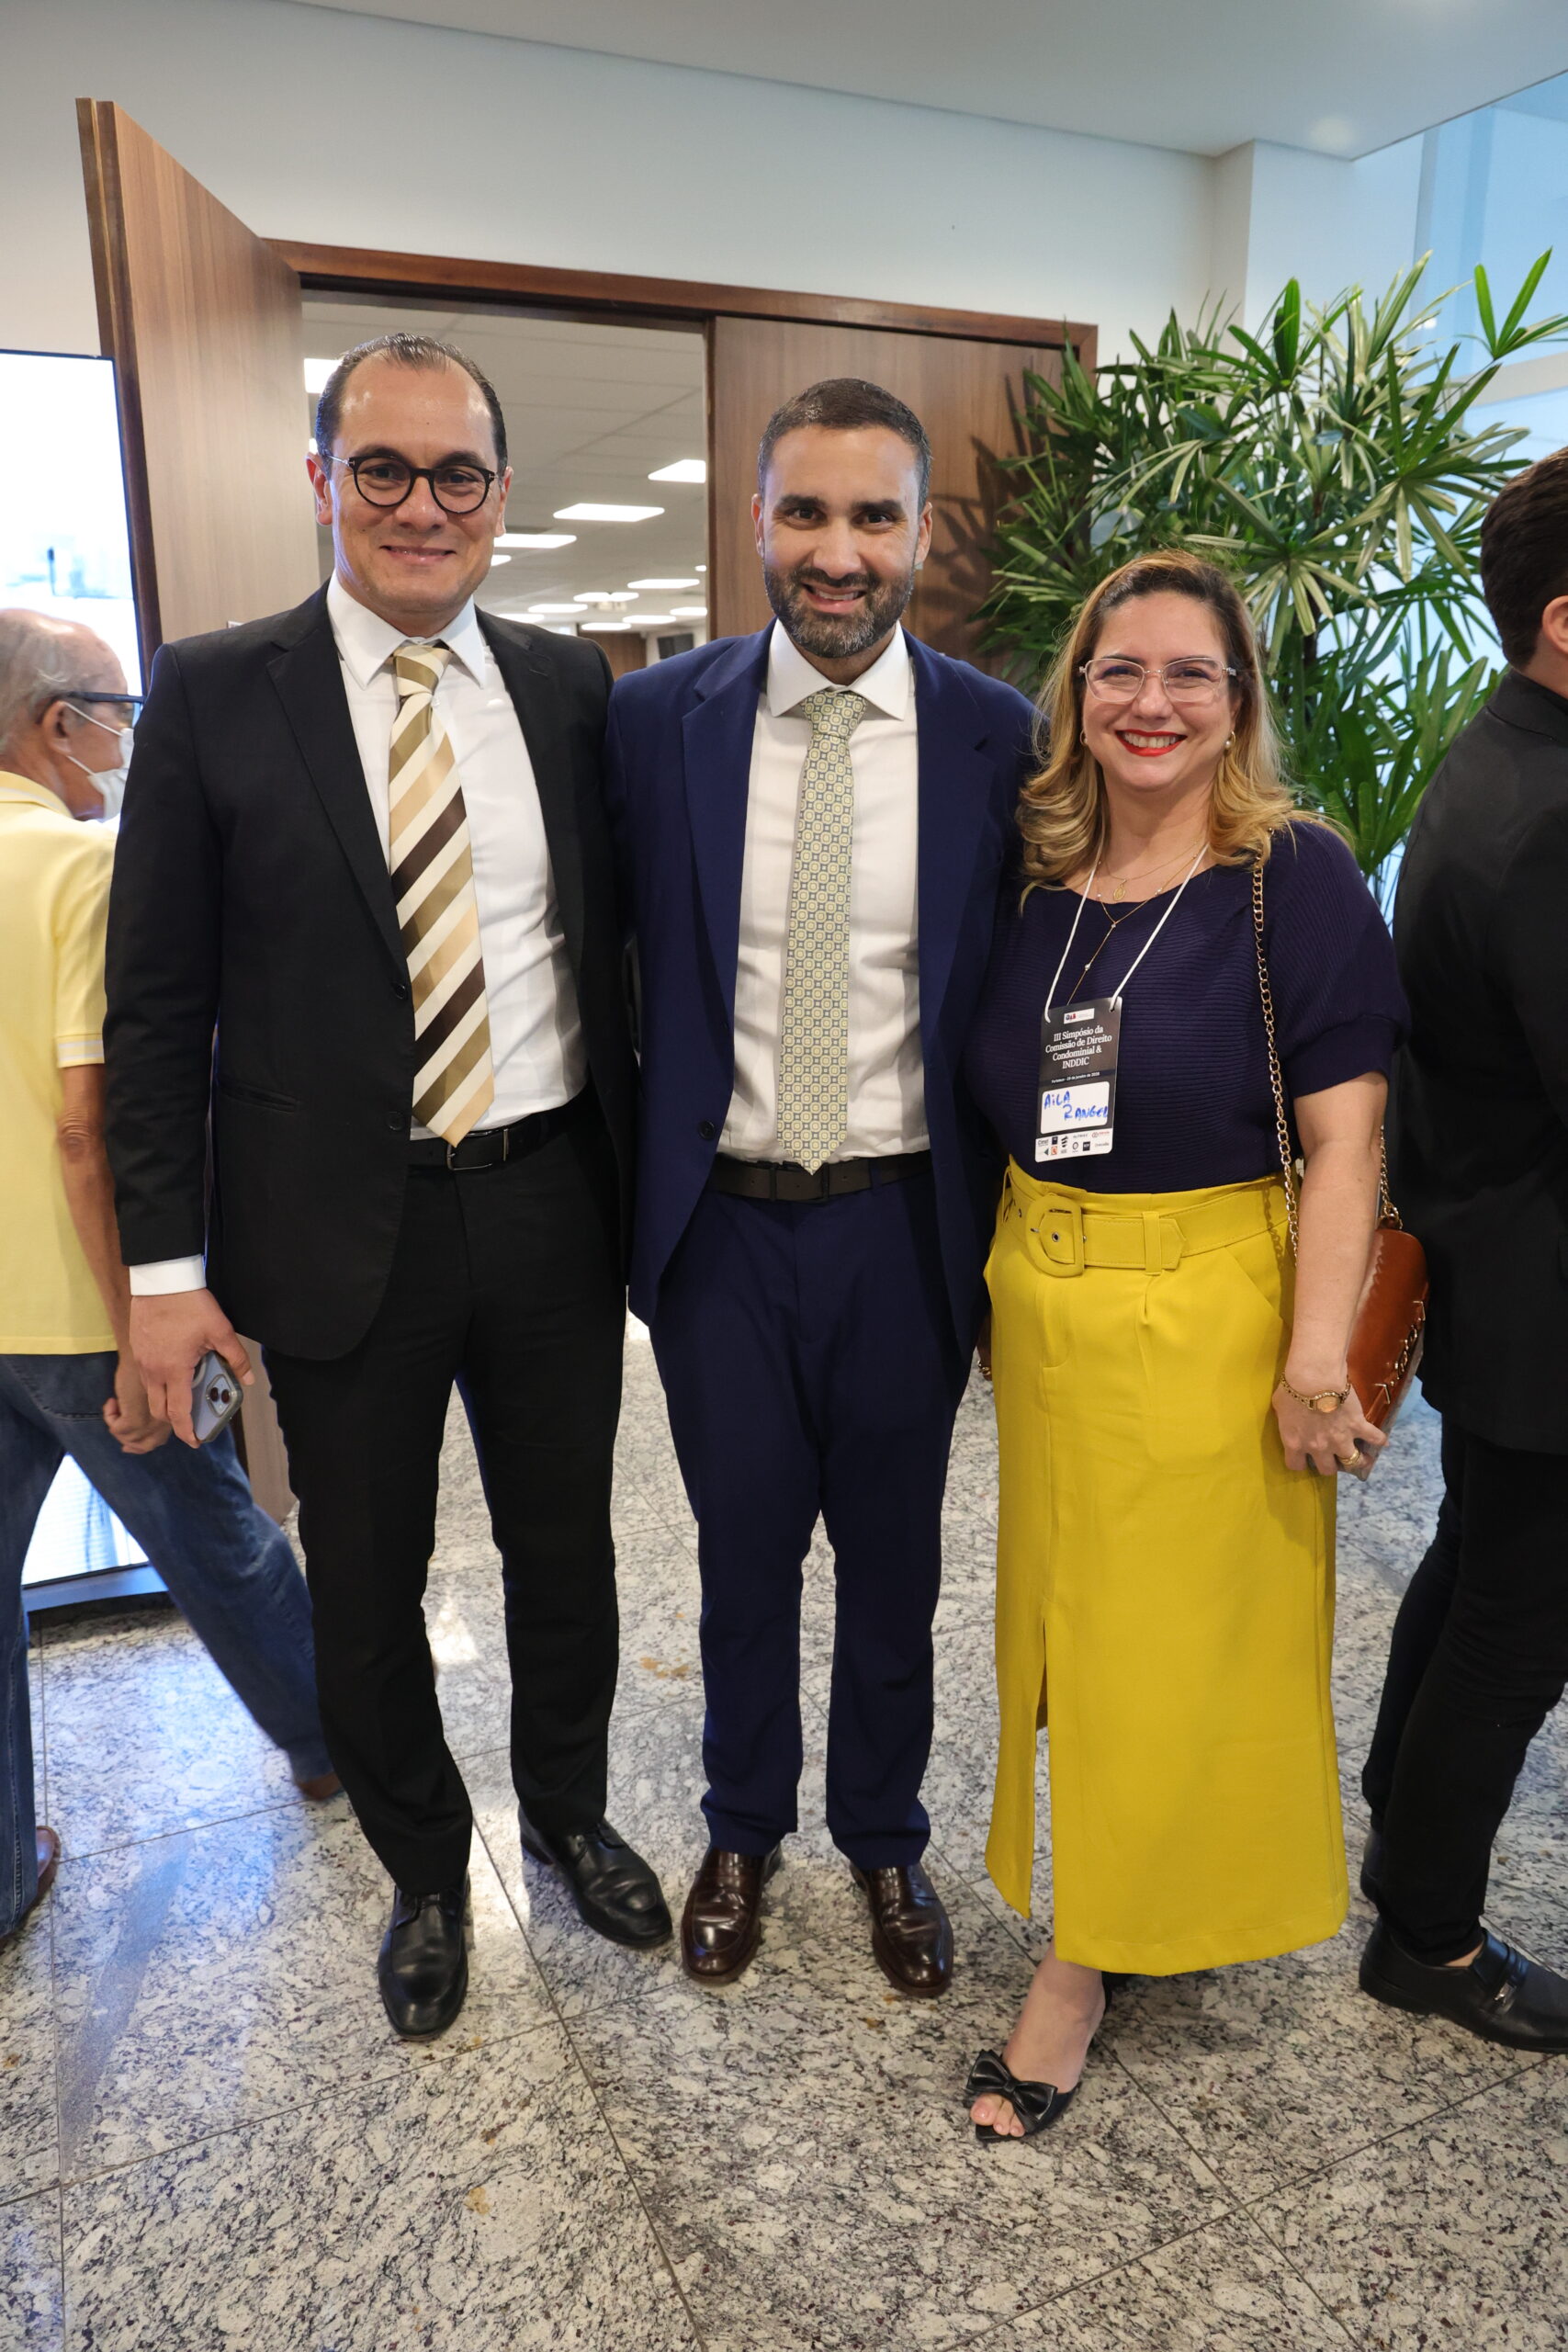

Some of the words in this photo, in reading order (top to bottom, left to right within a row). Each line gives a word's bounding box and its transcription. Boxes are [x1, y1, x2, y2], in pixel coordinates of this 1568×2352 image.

[1054, 1032, 1062, 1042] III
[1062, 1027, 1094, 1040] Simpósio
[1094, 1024, 1104, 1035] da
[1045, 1040, 1076, 1054] Comissão
[1077, 1038, 1086, 1046] de
[1087, 1035, 1112, 1046] Direito
[1052, 1046, 1095, 1061] Condominial
[1095, 1045, 1102, 1054] &
[1062, 1057, 1089, 1069] INDDIC
